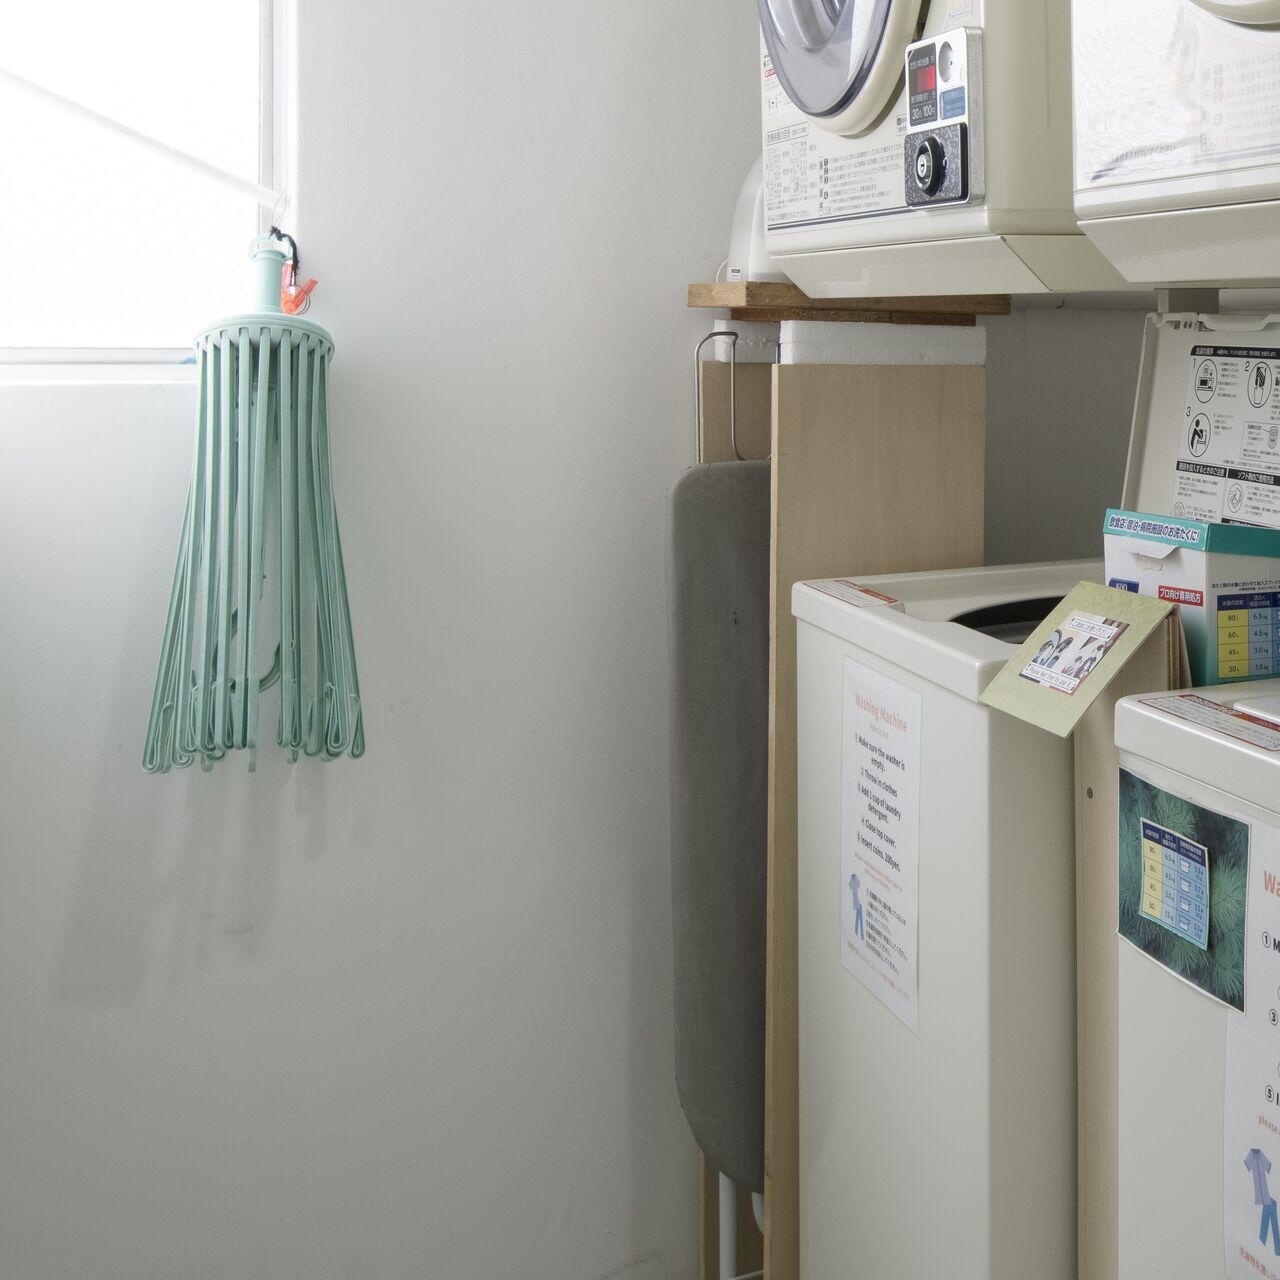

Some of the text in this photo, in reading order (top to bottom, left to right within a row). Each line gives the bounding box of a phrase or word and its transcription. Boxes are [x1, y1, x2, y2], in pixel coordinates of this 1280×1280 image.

[1244, 361, 1250, 372] 2
[1186, 406, 1191, 417] 3
[855, 692, 879, 721] Washing
[880, 707, 907, 732] Machine
[859, 735, 905, 771] Make sure the washer is
[871, 757, 885, 772] empty.
[864, 769, 897, 797] Throw in clothes
[861, 785, 869, 797] Add
[872, 794, 880, 806] cup
[885, 801, 901, 821] laundry
[861, 835, 872, 851] Insert
[865, 819, 876, 833] Close
[883, 833, 896, 849] cover.
[1258, 1115, 1278, 1134] please
